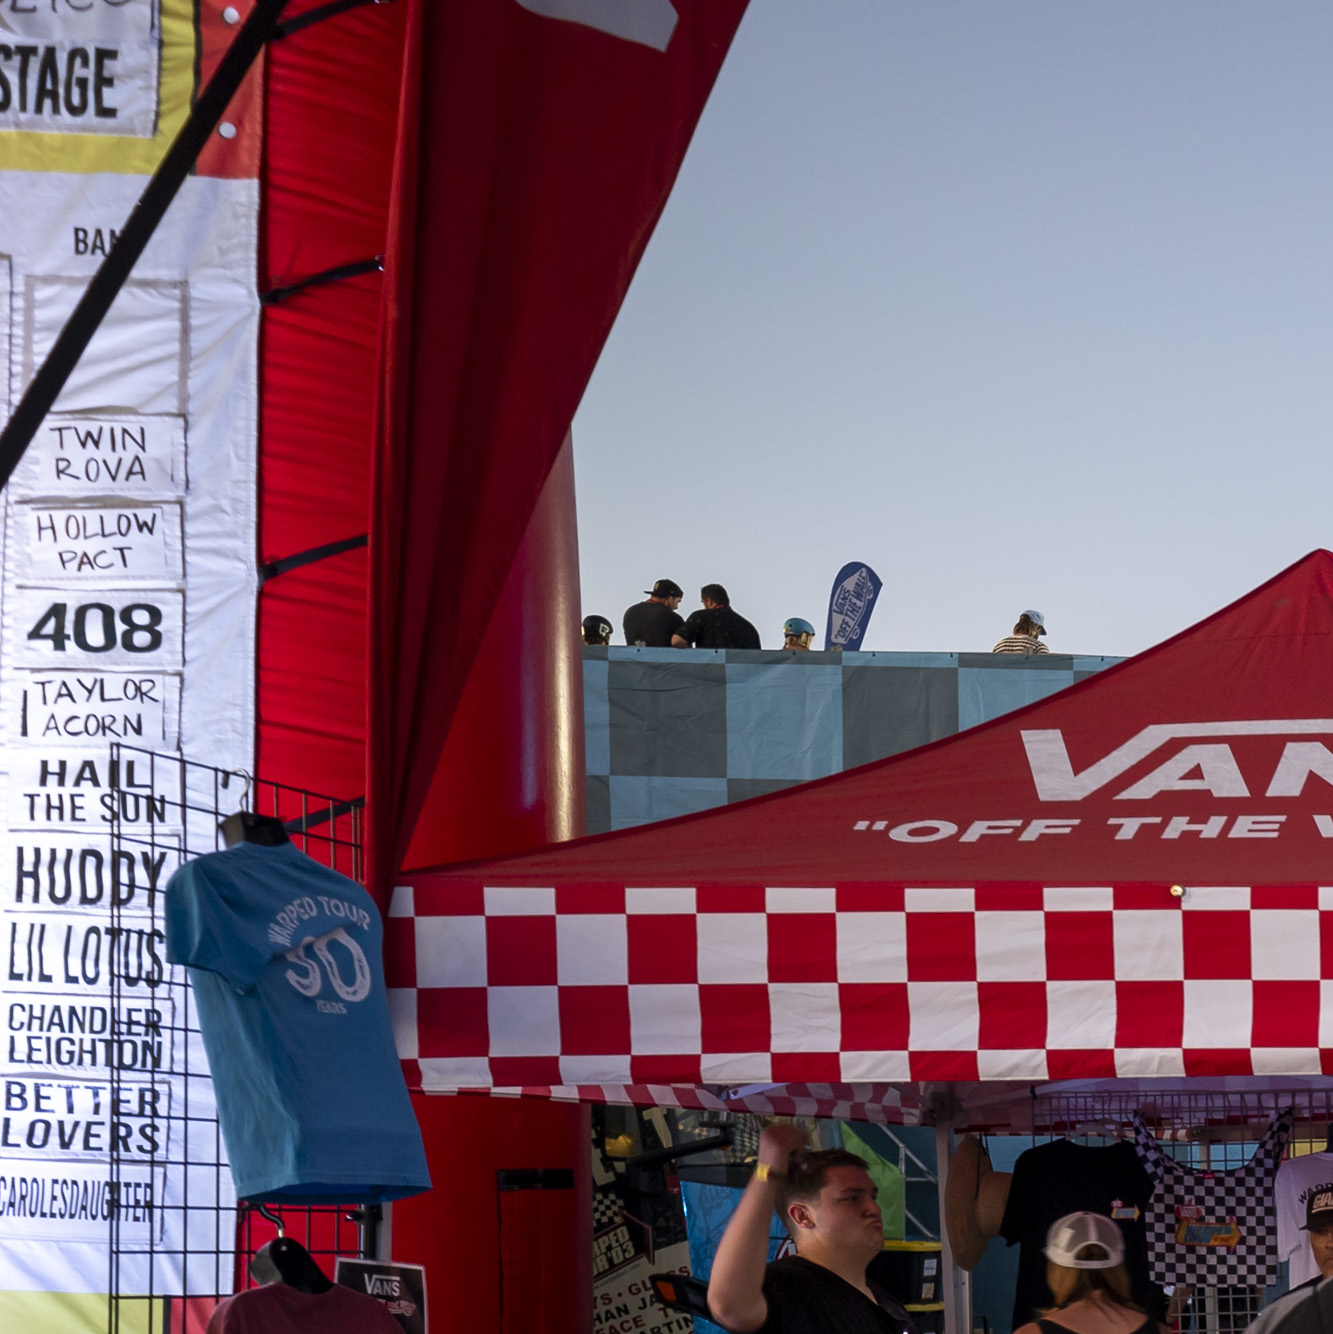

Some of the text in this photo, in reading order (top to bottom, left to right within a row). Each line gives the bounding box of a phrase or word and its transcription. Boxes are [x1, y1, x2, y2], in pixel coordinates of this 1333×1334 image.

[49, 425, 146, 452] TWIN
[55, 455, 146, 482] ROVA
[37, 513, 156, 542] HOLLOW
[58, 547, 132, 571] PACT
[833, 585, 851, 616] VANS
[27, 603, 162, 653] 408
[33, 677, 159, 705] TAYLOR
[42, 713, 143, 737] ACORN
[39, 760, 152, 788] HAIL
[23, 793, 165, 823] THE SUN
[854, 816, 1081, 843] "OFF
[1106, 815, 1287, 840] THE
[16, 846, 167, 907] HUDDY
[317, 896, 371, 931] TOUR
[8, 922, 164, 988] LIL LOTUS
[8, 1003, 162, 1037] CHANDLER
[8, 1035, 162, 1069] LEIGHTON
[5, 1080, 160, 1117] BETTER
[1, 1117, 160, 1154] LOVERS
[363, 1272, 401, 1297] VANS
